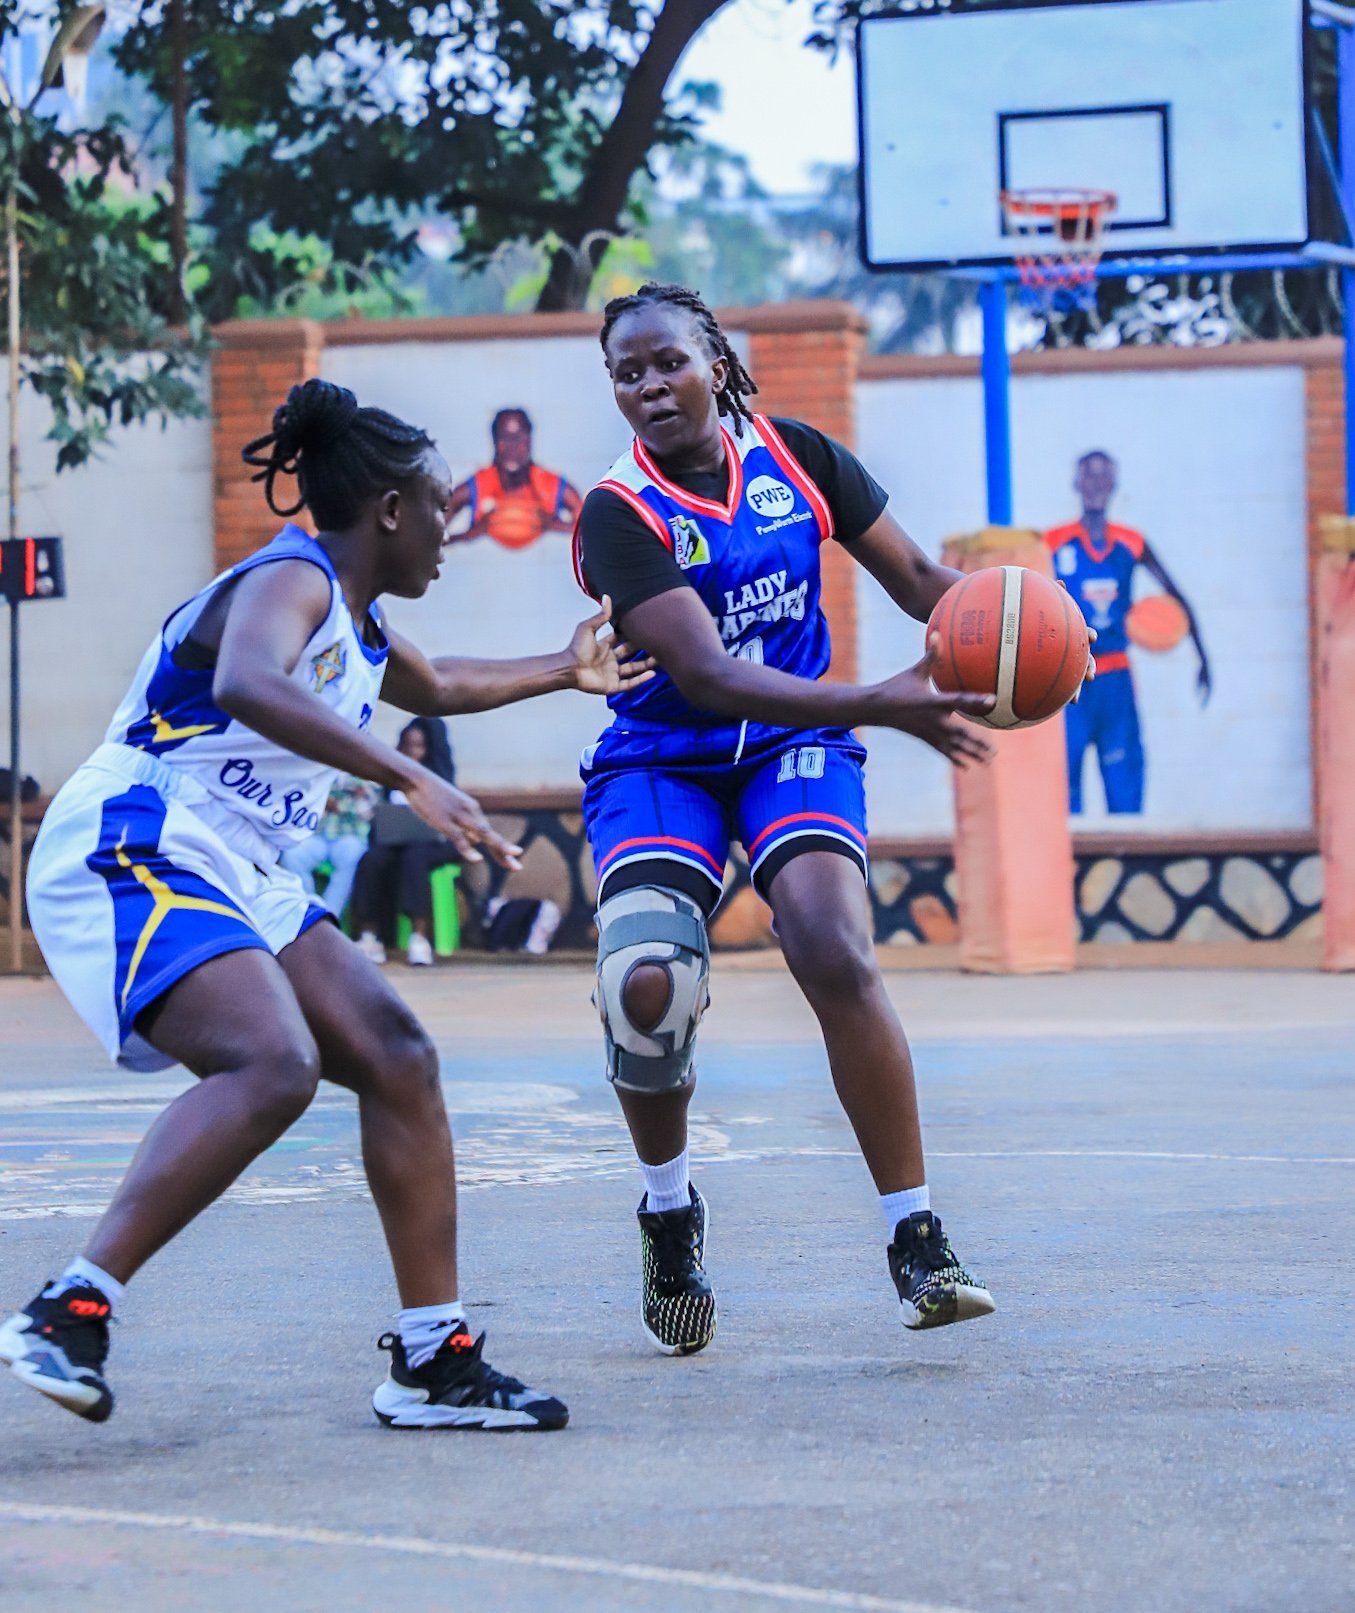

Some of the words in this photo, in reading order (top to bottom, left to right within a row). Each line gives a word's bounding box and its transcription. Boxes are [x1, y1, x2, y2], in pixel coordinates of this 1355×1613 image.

[750, 486, 791, 509] PWE
[712, 579, 808, 640] ARNES
[724, 569, 787, 614] LADY
[219, 758, 273, 807] Our
[776, 746, 825, 784] 10
